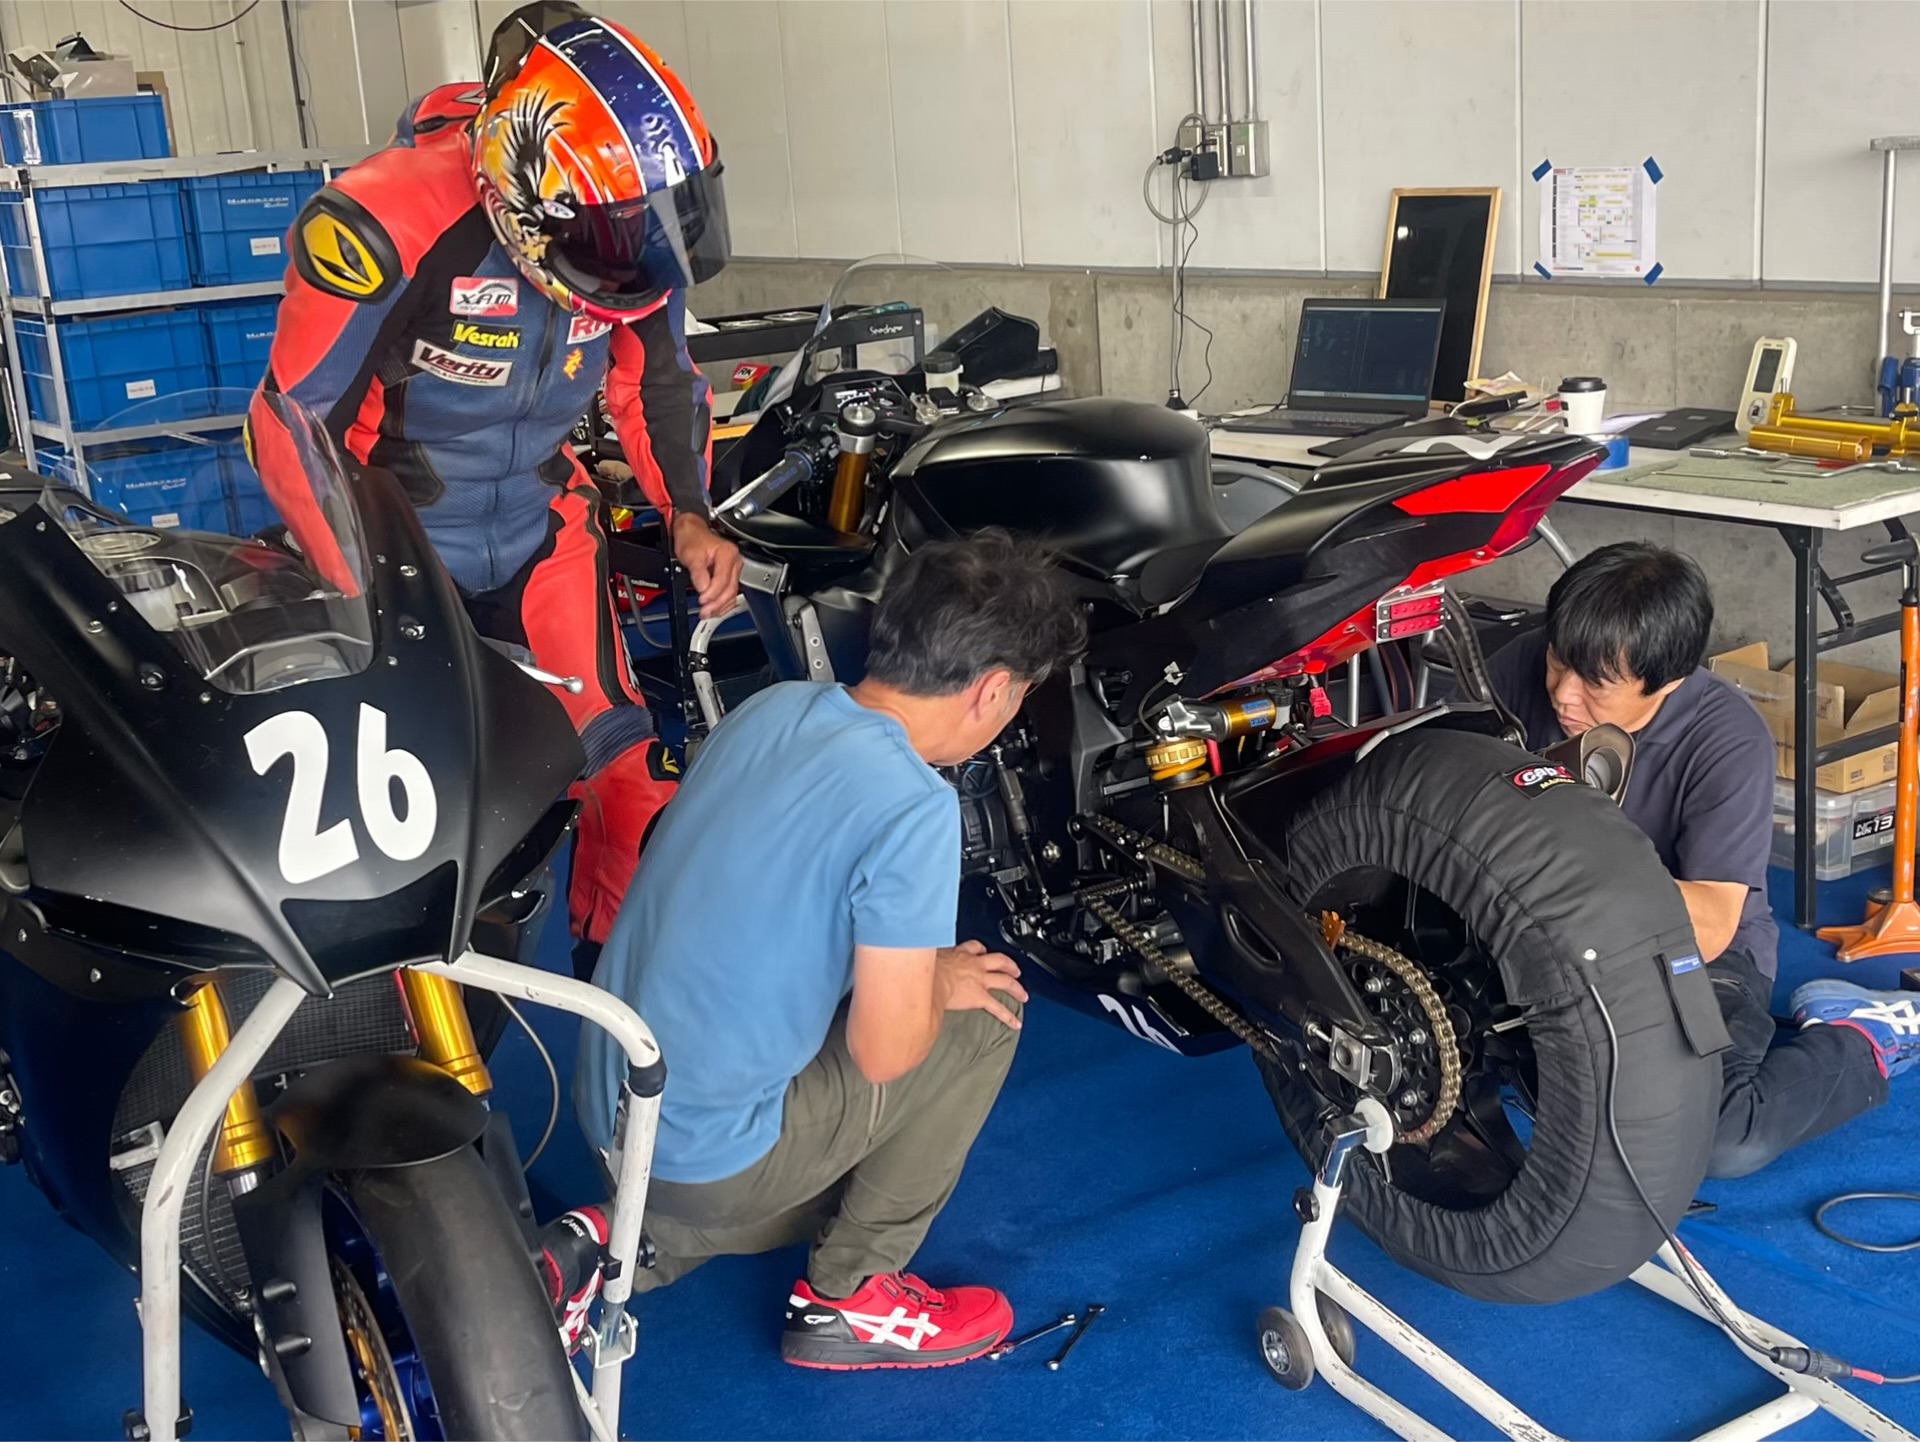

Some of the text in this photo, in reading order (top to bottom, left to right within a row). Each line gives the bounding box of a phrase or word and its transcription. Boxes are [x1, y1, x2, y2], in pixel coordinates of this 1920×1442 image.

[453, 323, 519, 350] Vesrah
[419, 346, 505, 380] Verity
[243, 702, 437, 884] 26
[1873, 815, 1894, 832] 13
